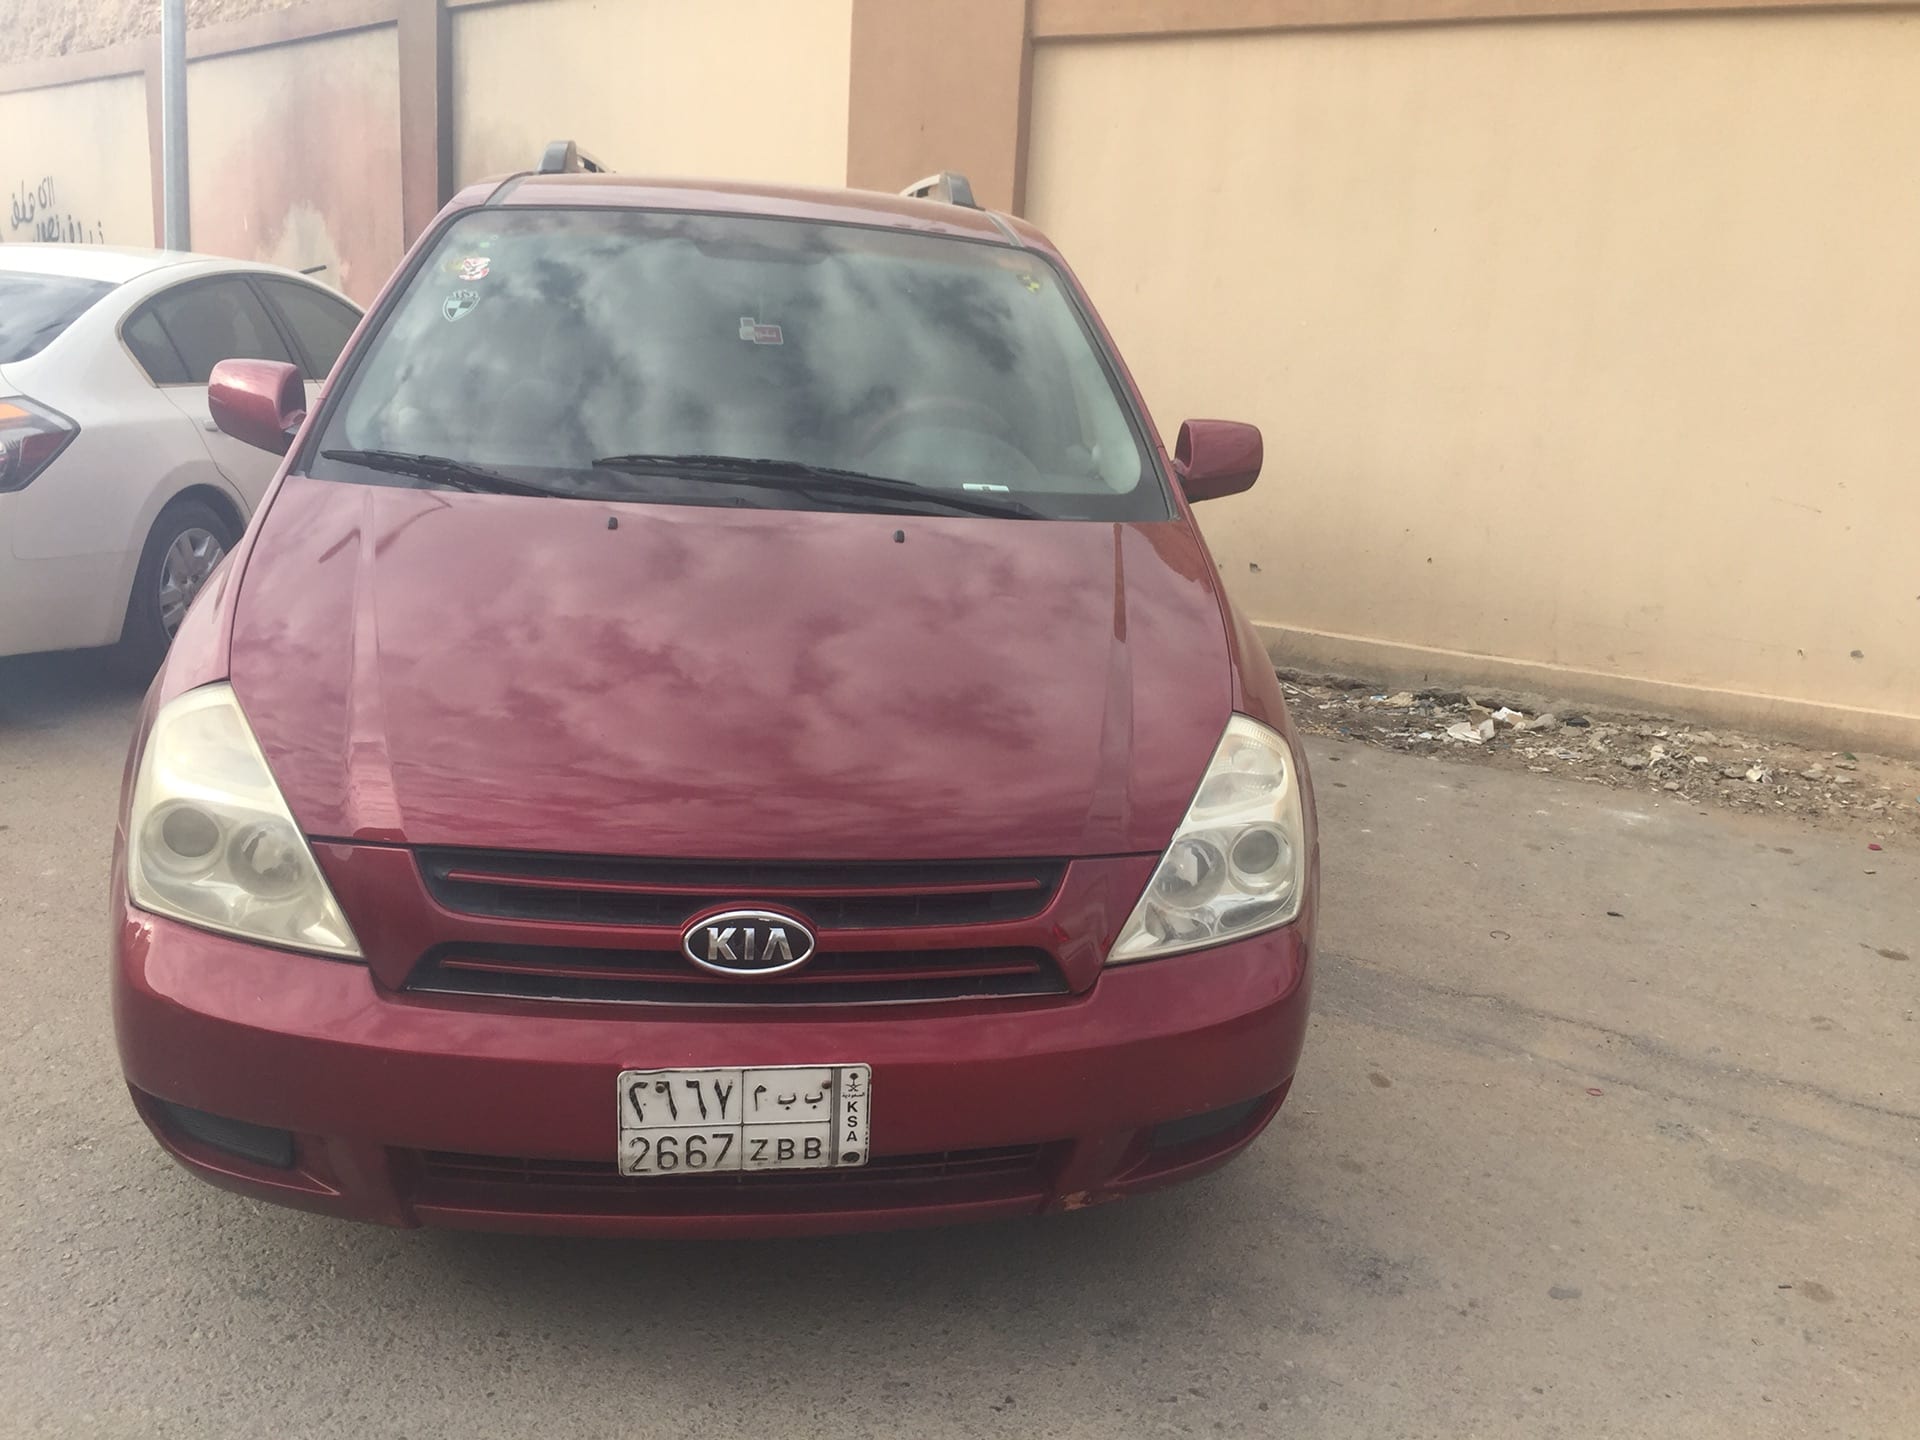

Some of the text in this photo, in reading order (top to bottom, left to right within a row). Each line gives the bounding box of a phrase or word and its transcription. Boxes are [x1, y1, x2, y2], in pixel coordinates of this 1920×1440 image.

[706, 927, 794, 961] KIA
[628, 1132, 734, 1173] 2667
[750, 1136, 822, 1162] ZBB
